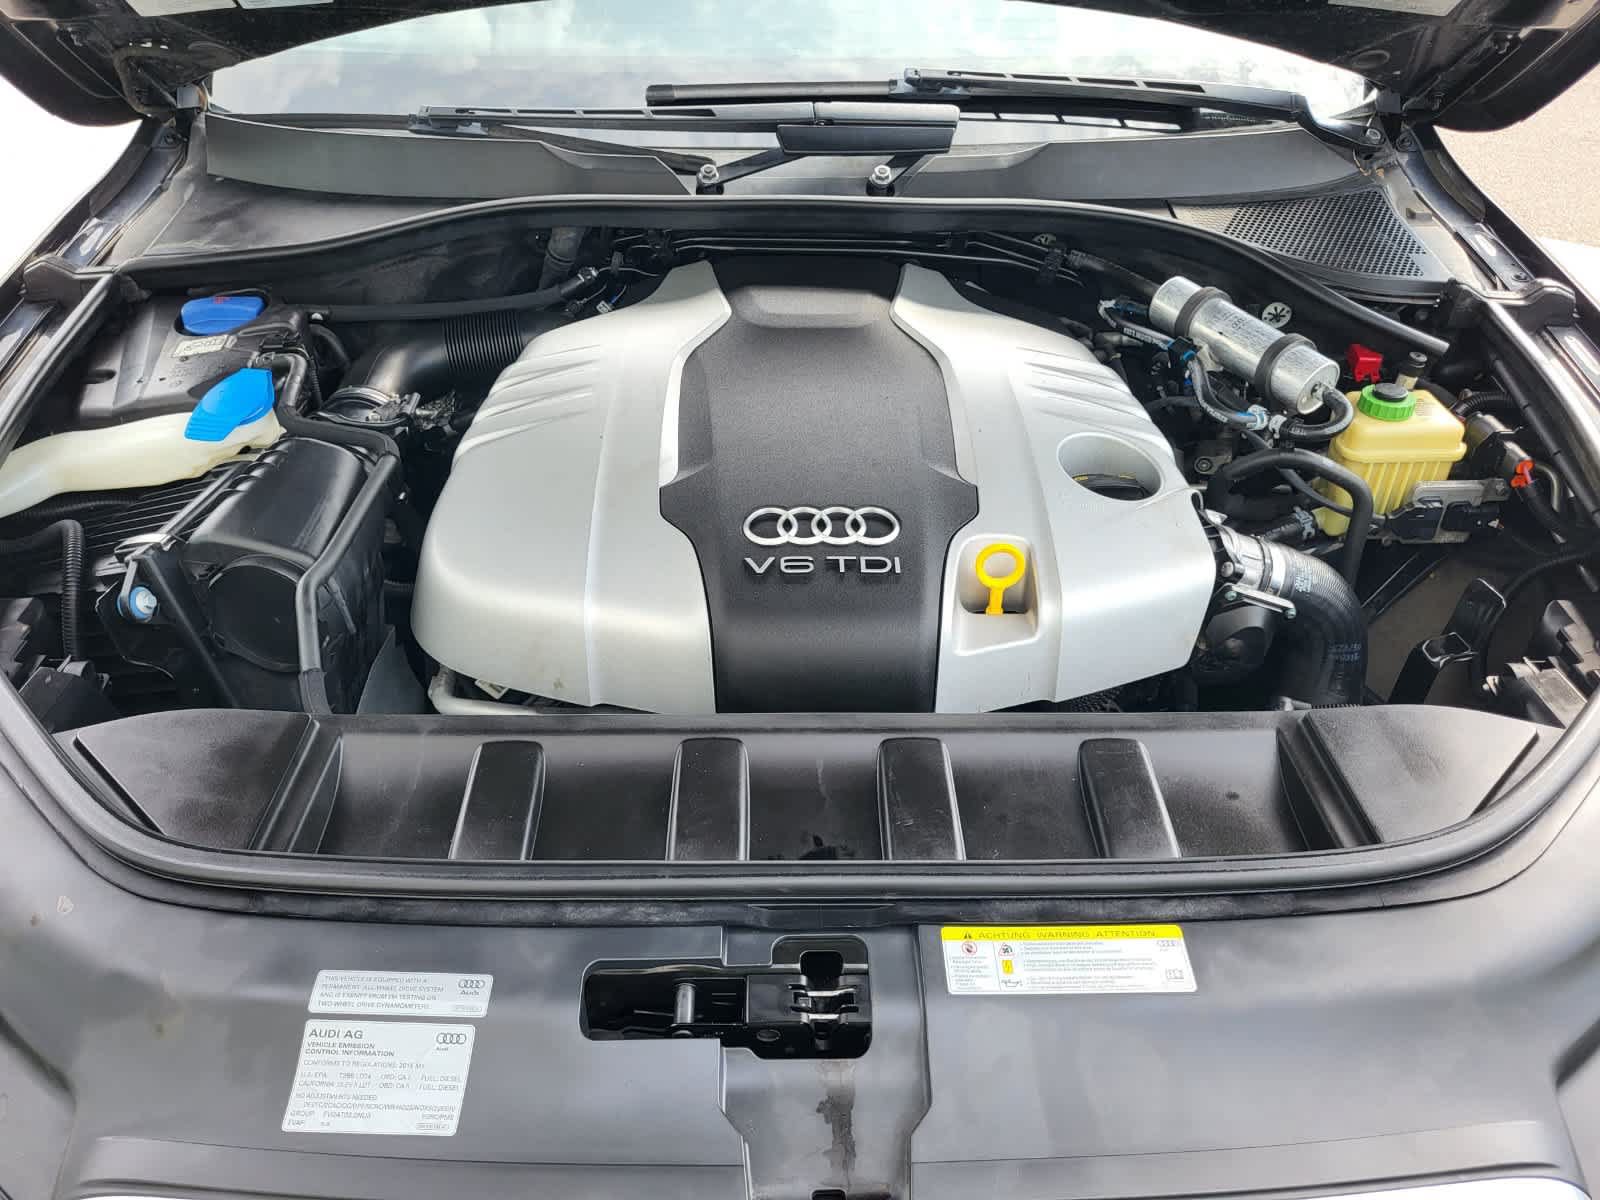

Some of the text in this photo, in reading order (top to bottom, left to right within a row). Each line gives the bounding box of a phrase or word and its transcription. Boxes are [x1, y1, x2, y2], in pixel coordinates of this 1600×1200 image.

[744, 556, 901, 574] V6 TDI
[978, 931, 1031, 939] ACHTUNG
[308, 1029, 364, 1040] AUDI AG
